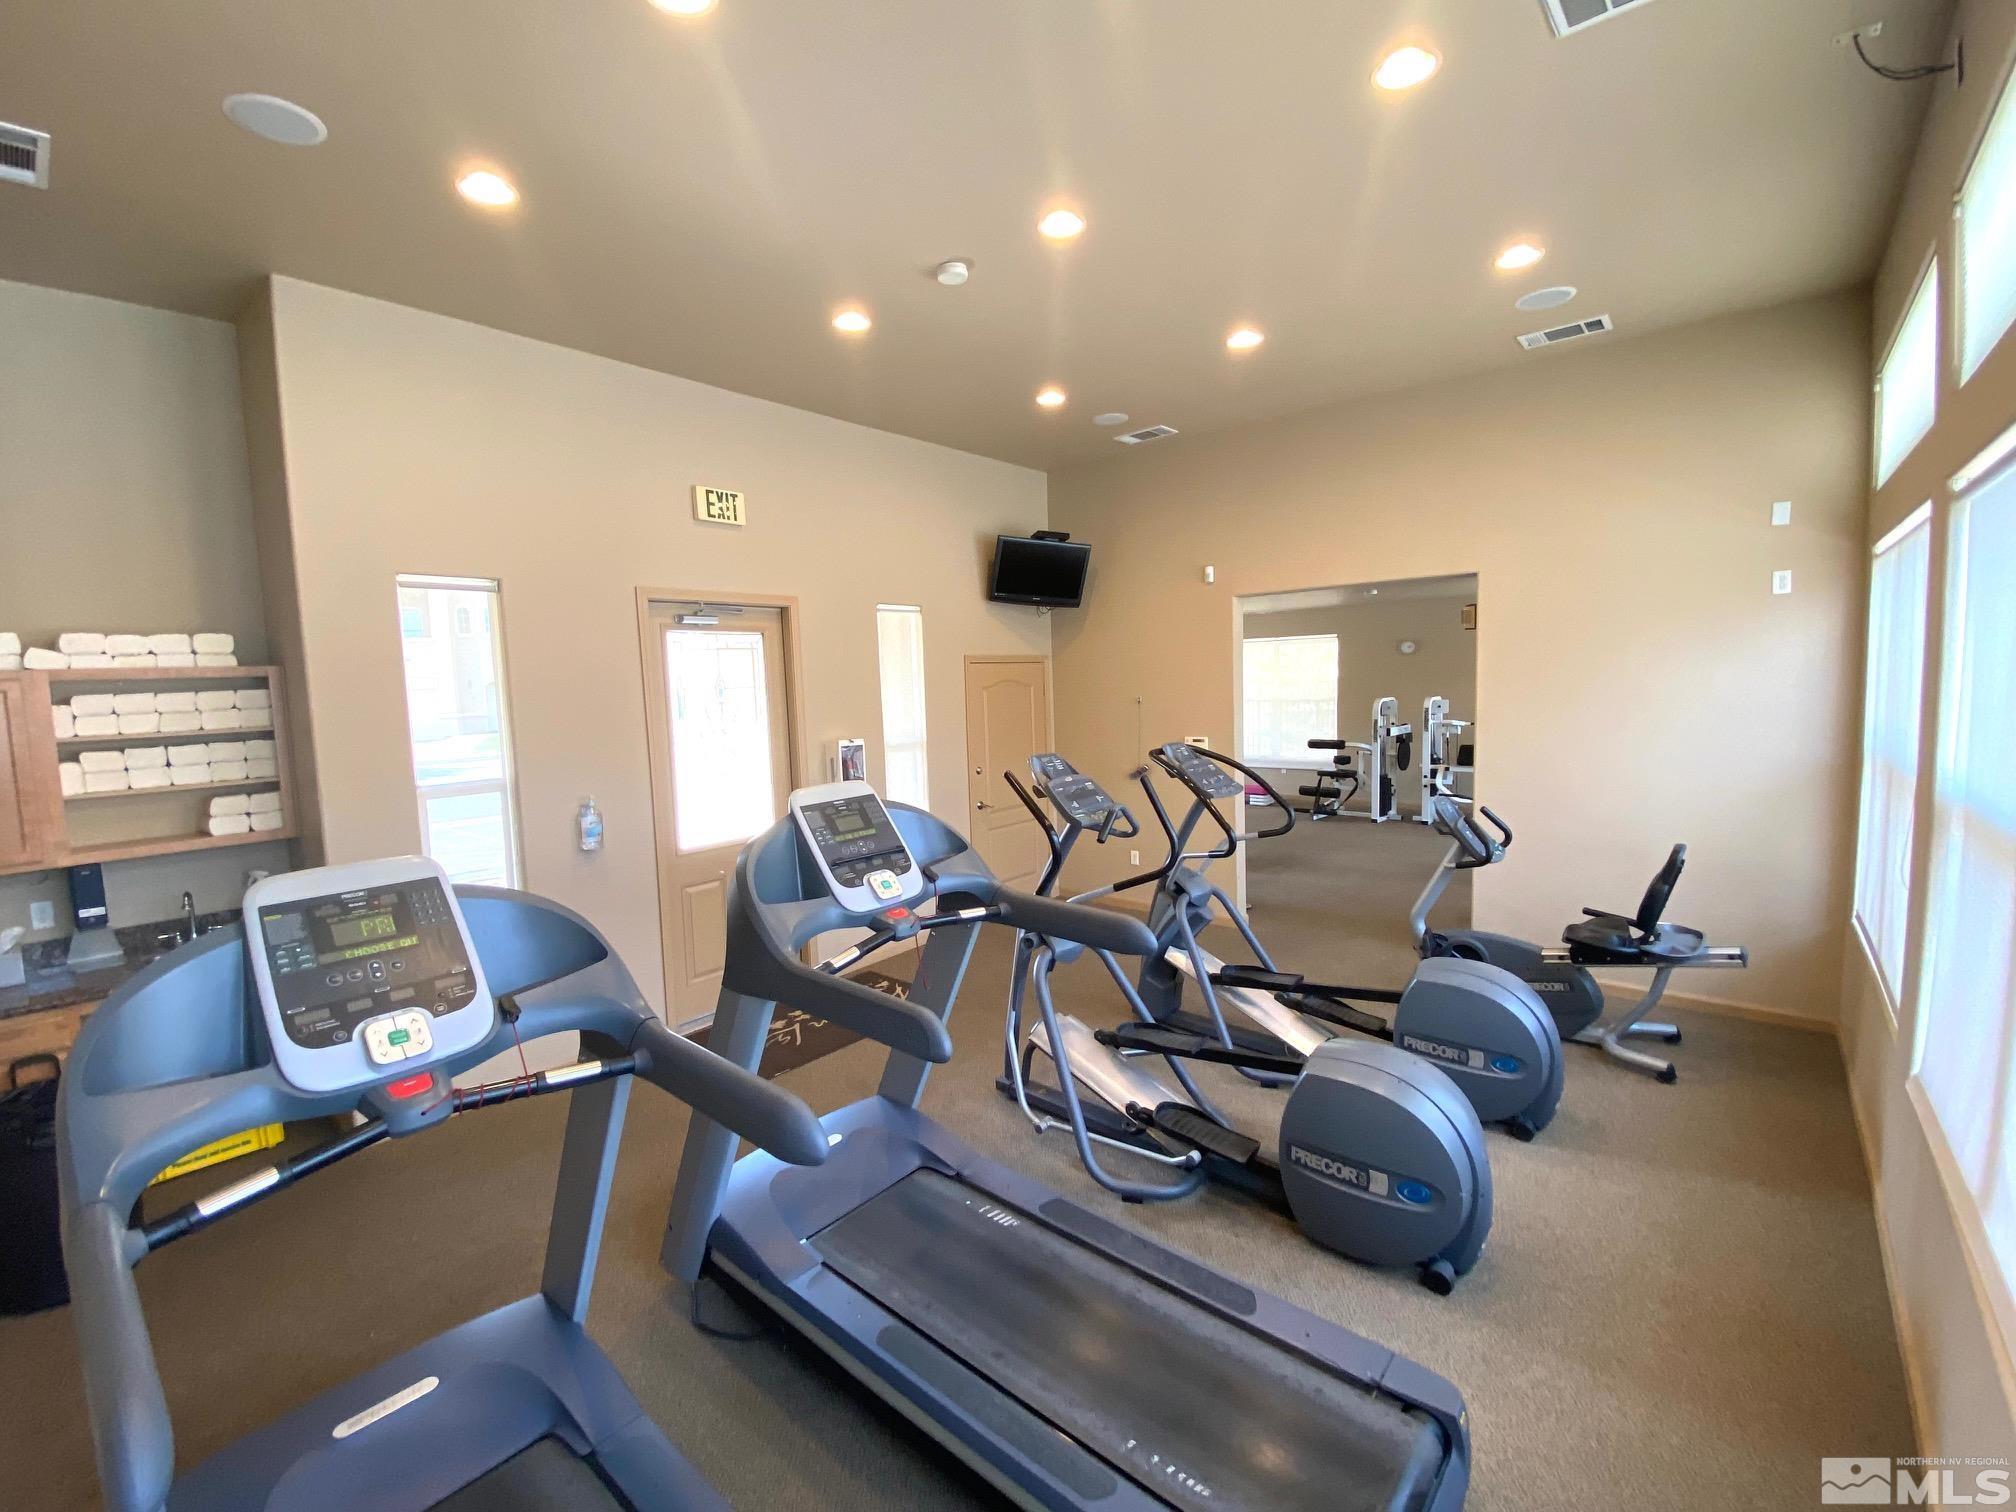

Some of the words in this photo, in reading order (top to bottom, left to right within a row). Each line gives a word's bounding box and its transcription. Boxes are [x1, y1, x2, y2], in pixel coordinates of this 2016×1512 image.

[705, 489, 738, 521] EXIT
[1403, 1035, 1459, 1060] PRECOR
[1291, 1145, 1358, 1184] PRECOR
